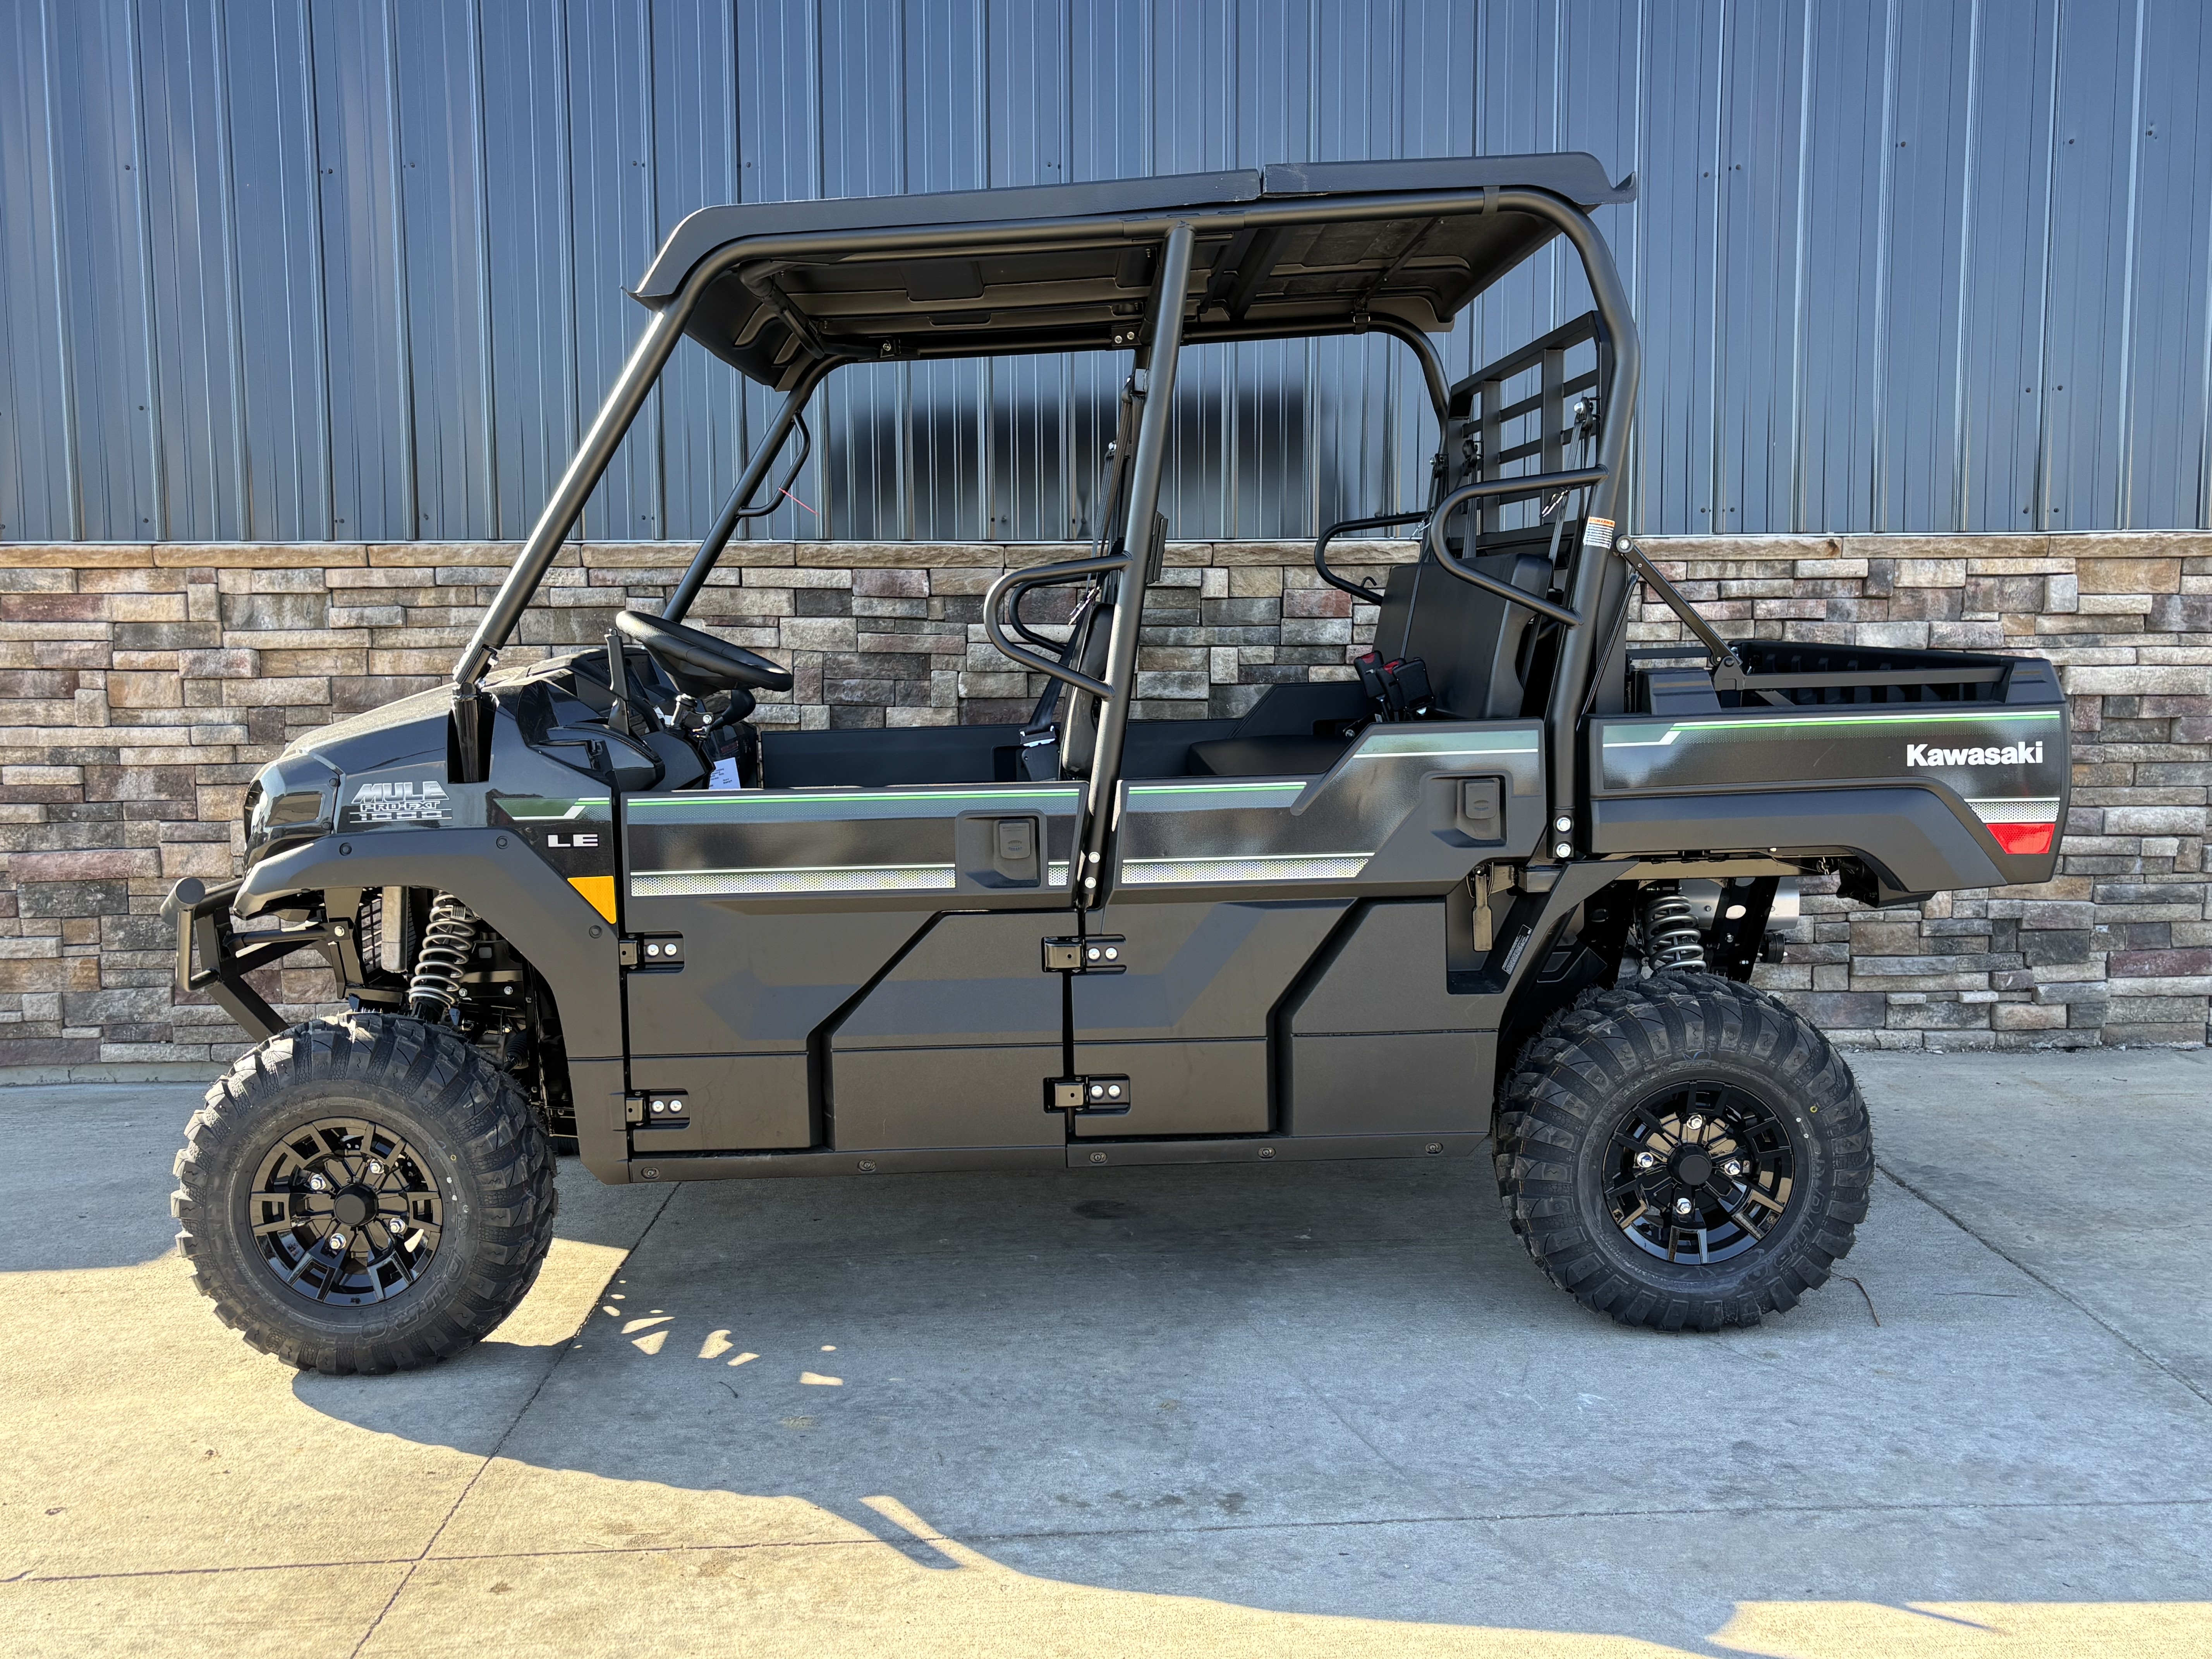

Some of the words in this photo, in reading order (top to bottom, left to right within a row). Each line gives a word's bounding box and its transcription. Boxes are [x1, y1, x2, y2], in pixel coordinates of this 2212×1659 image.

[1907, 741, 2043, 766] Kawasaki
[351, 781, 450, 804] MULE
[360, 801, 440, 812] PRO-FXT
[359, 811, 442, 821] 1000
[548, 834, 598, 847] LE
